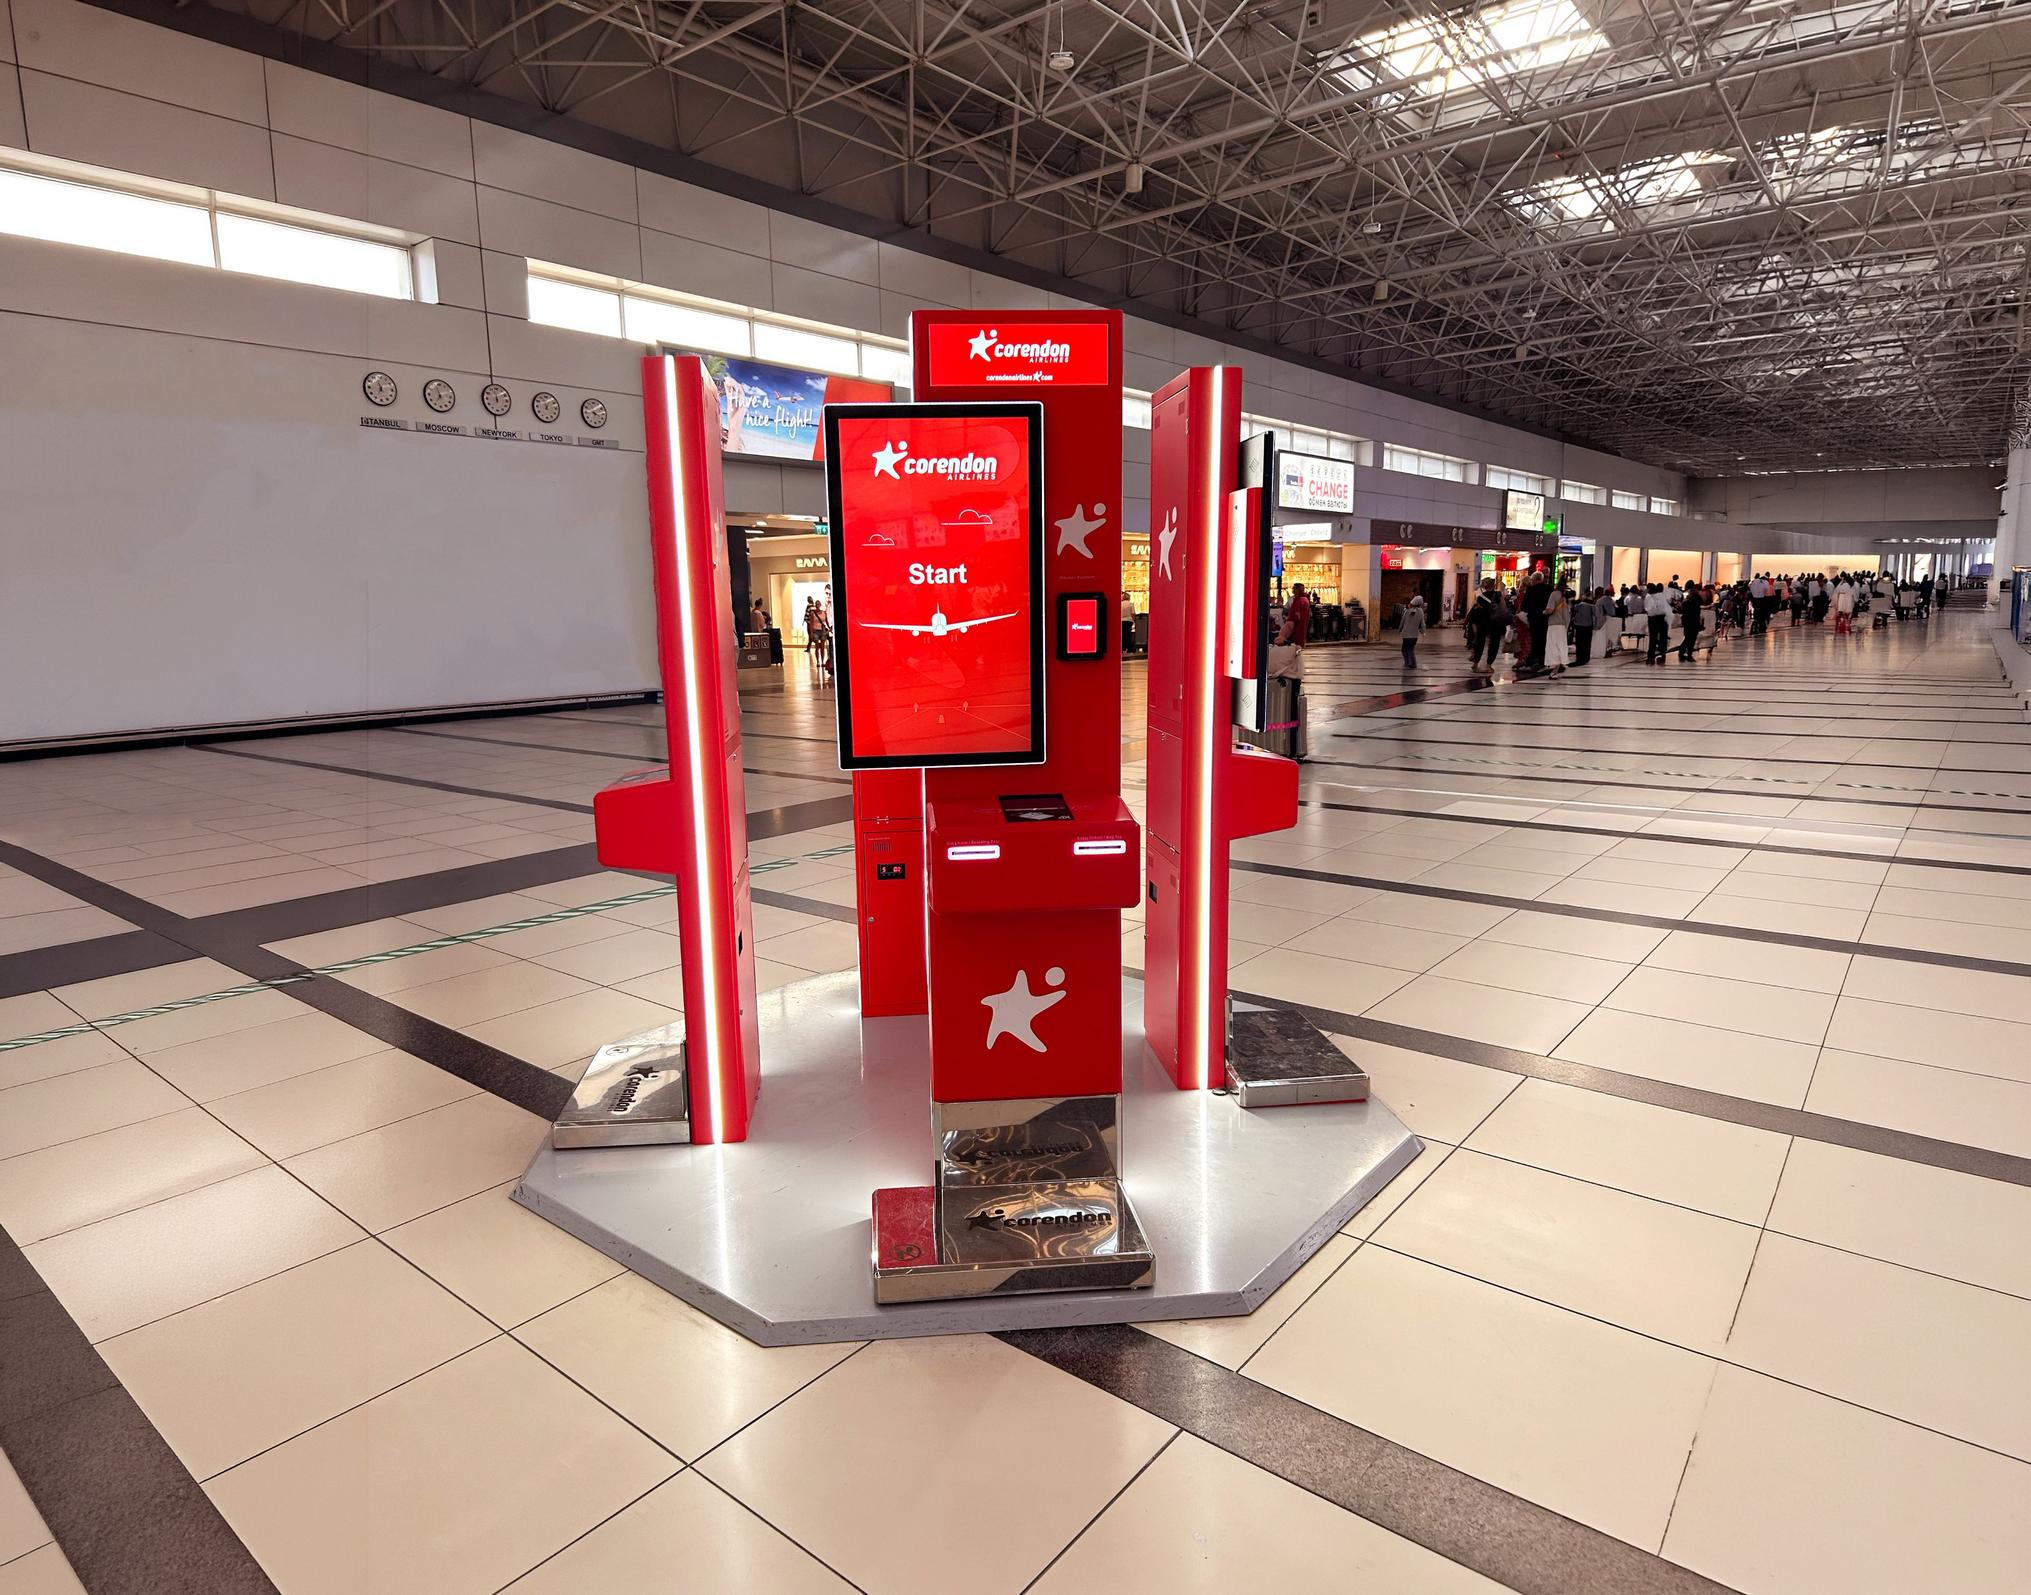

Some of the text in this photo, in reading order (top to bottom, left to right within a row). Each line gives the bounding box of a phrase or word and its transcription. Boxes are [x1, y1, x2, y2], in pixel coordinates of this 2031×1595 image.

[994, 339, 1071, 358] corendon
[1029, 356, 1070, 364] AIRLINES
[728, 387, 771, 409] Have a
[424, 423, 460, 434] MOSCOW
[745, 407, 813, 439] nice flight!
[481, 428, 517, 439] NEWYORK
[540, 433, 563, 442] TOKYO
[591, 438, 605, 446] GMT
[903, 452, 998, 475] corendon
[947, 472, 997, 481] AIRLINES
[1309, 480, 1348, 499] CHANGE
[909, 563, 967, 584] Start
[614, 1077, 642, 1112] corendon
[1003, 1211, 1112, 1228] corendon
